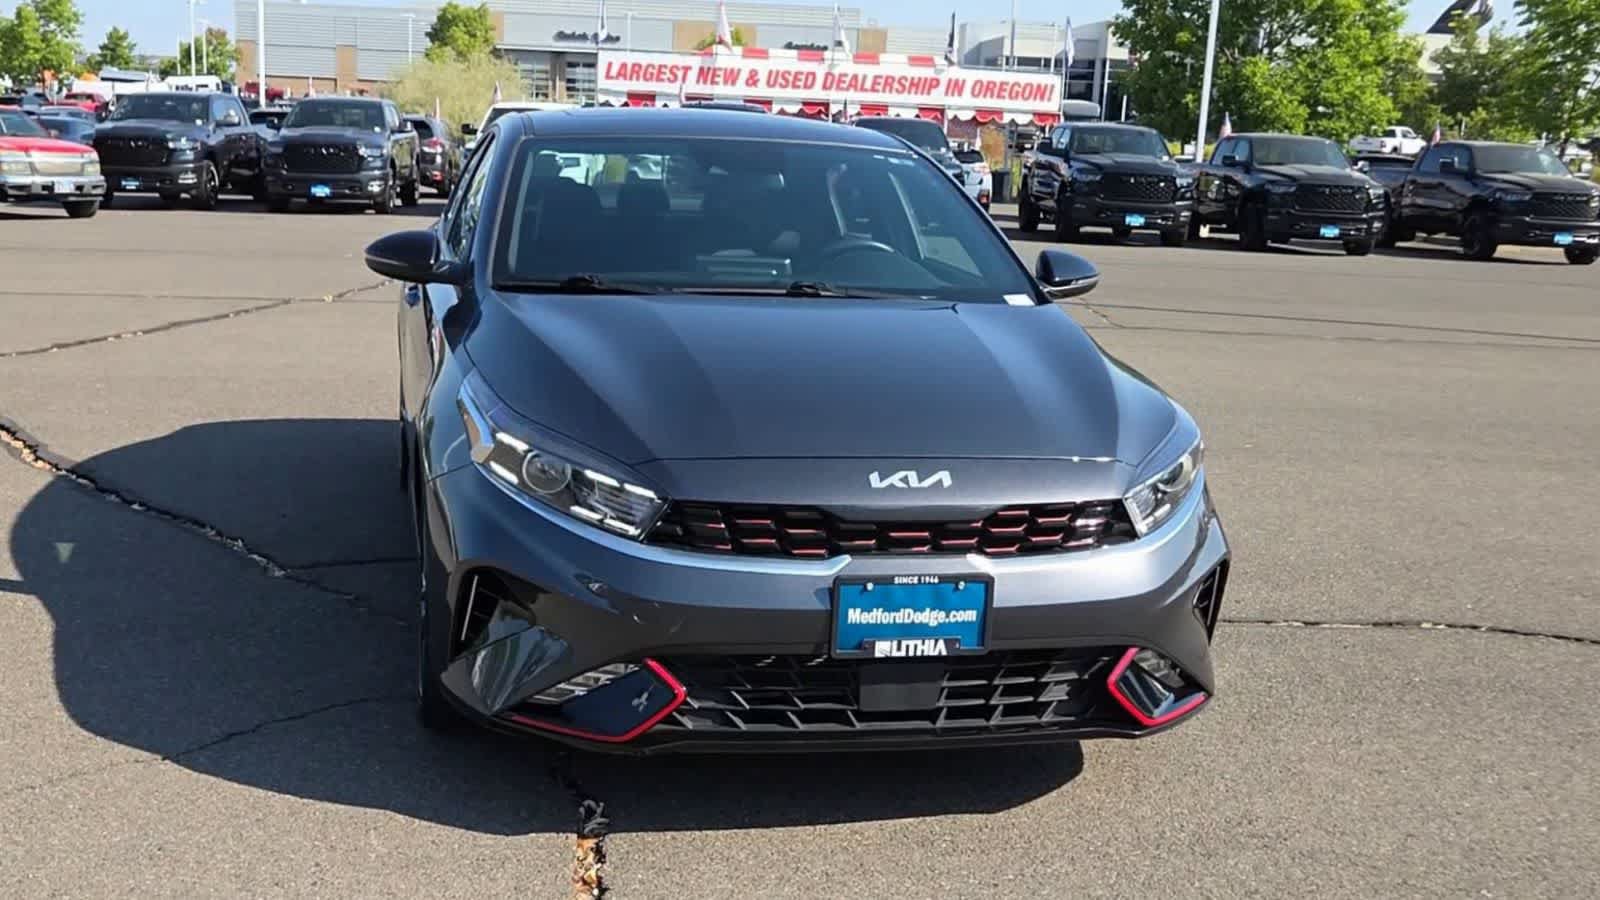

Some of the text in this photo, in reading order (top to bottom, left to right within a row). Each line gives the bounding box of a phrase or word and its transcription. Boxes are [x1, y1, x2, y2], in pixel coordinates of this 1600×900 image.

[604, 61, 1055, 102] LARGEST NEW & USED DEALERSHIP IN OREGON!
[868, 470, 952, 488] KIA
[893, 575, 939, 585] SINCE 1946
[847, 607, 977, 627] MedfordDodge.com
[890, 638, 948, 657] LITHIA
